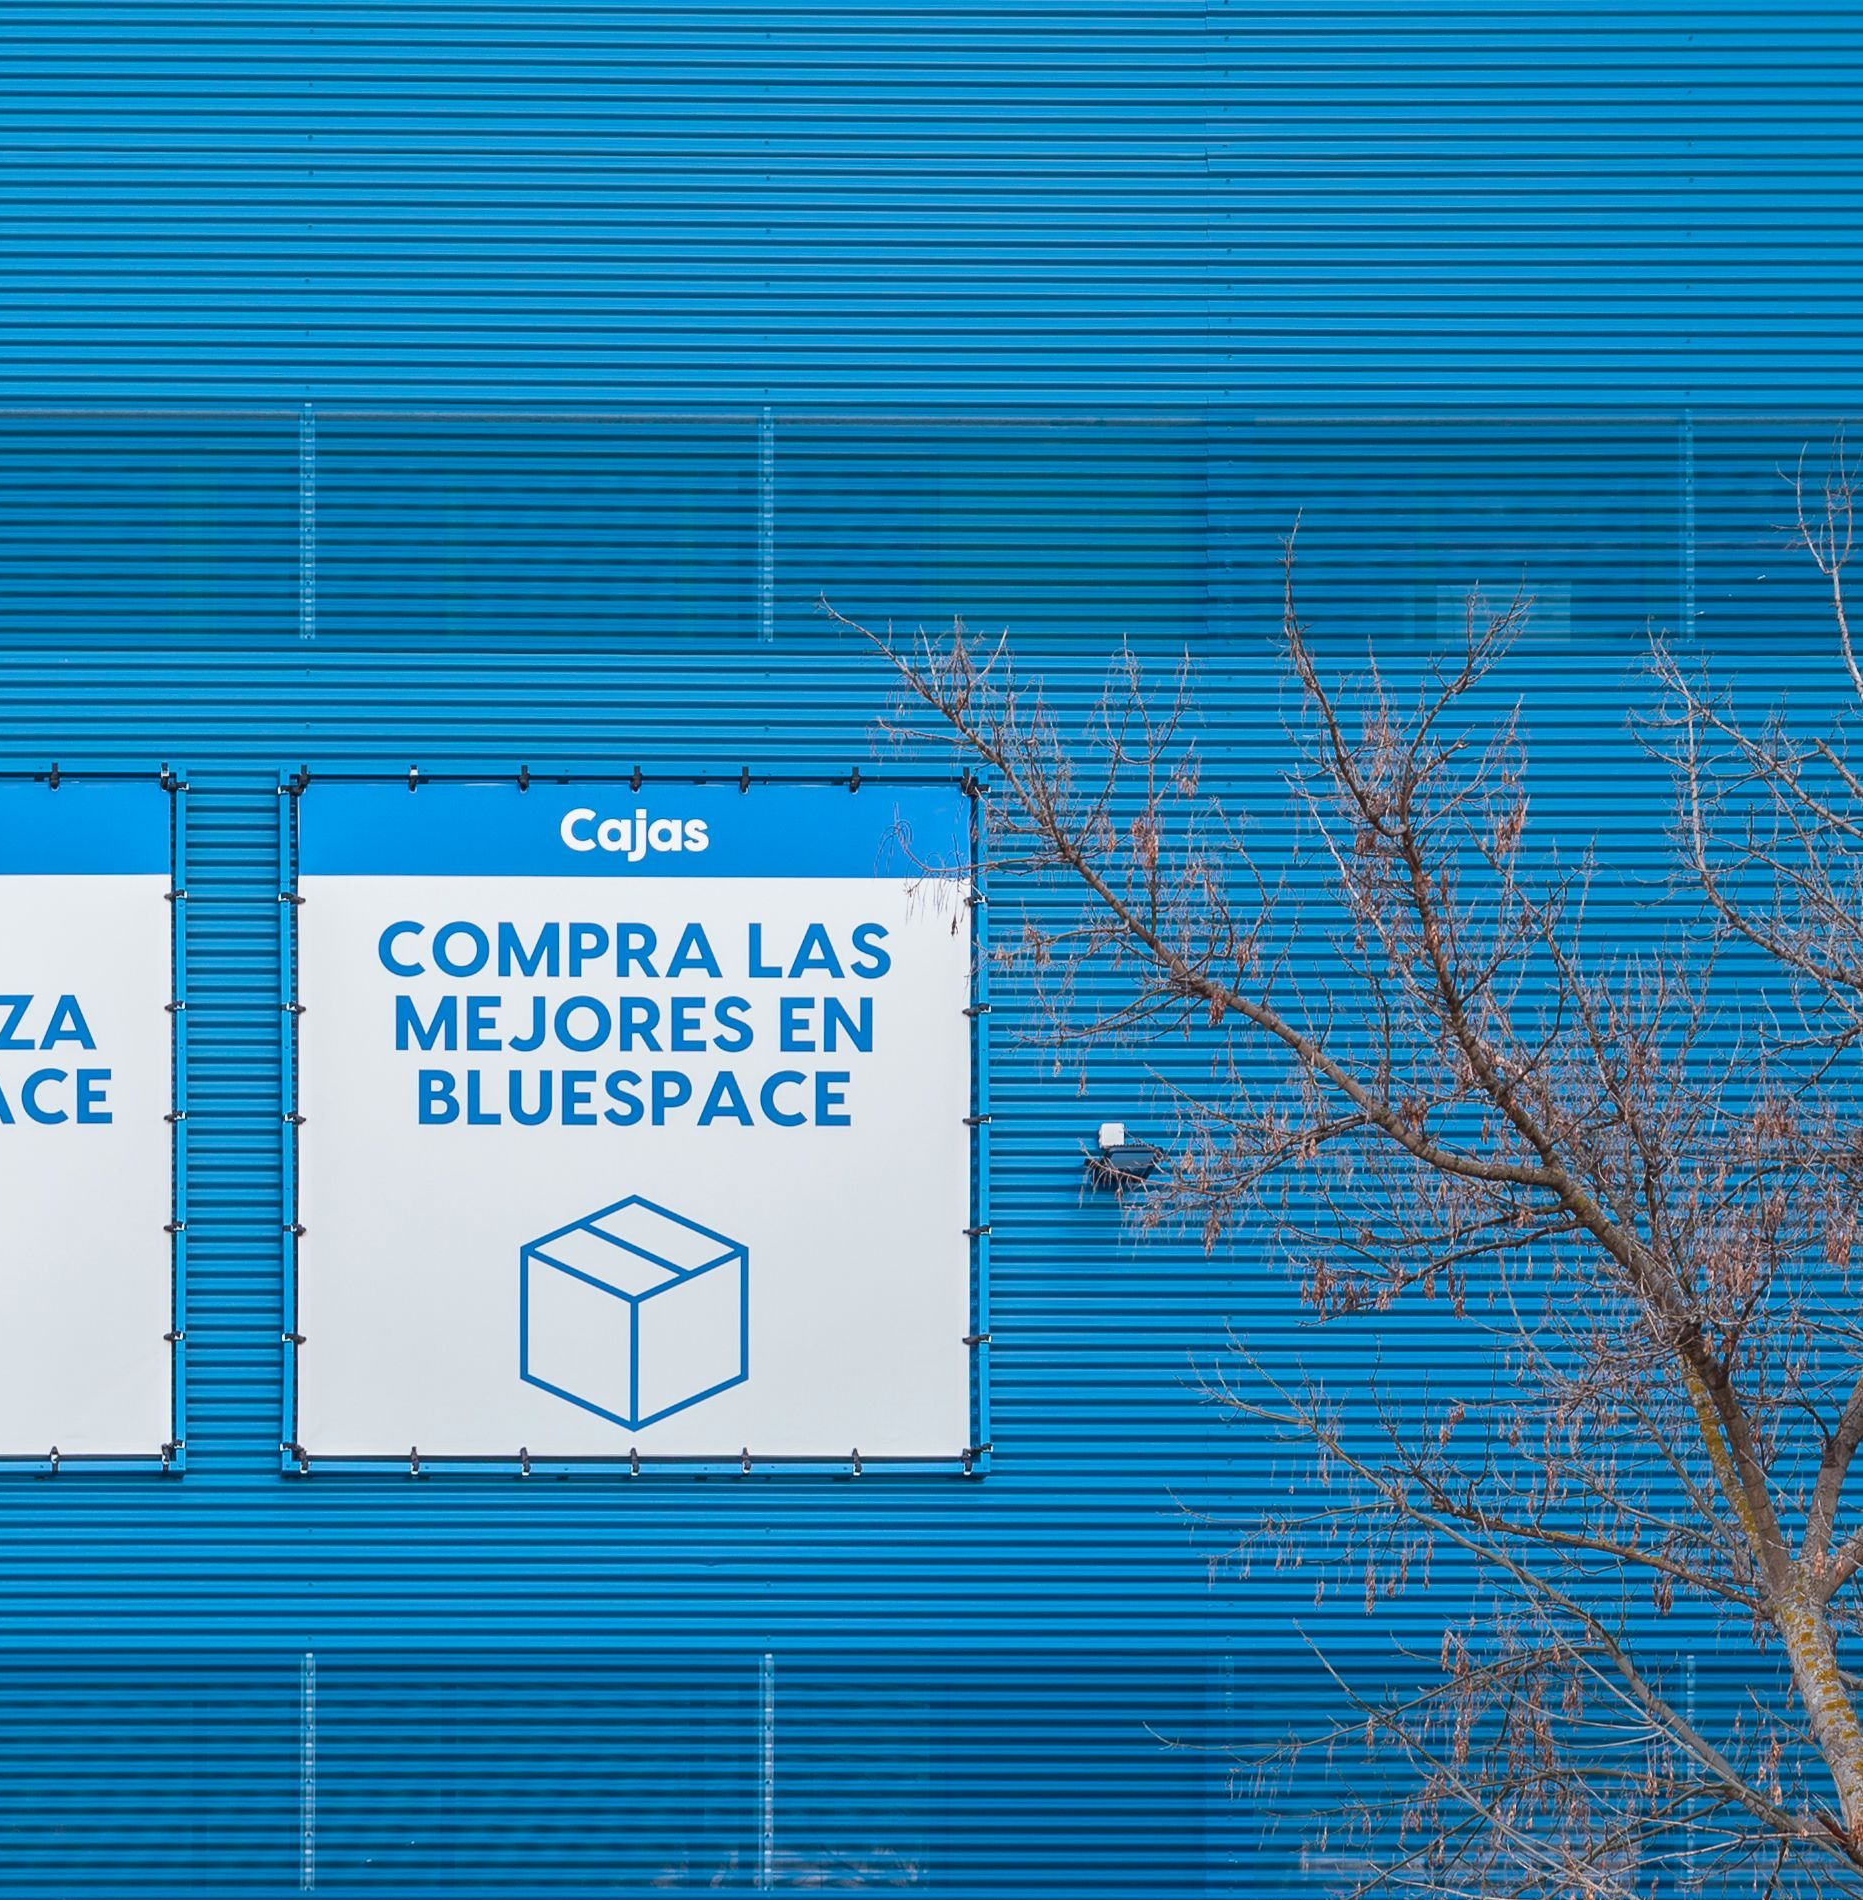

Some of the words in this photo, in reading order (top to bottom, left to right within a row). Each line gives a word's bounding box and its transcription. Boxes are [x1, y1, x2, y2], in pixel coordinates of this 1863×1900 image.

[560, 808, 709, 861] Cajas
[377, 920, 723, 978] COMPRA
[748, 922, 892, 979] LAS
[395, 994, 754, 1053] MEJORES
[779, 997, 873, 1053] EN
[418, 1069, 851, 1127] BLUESPACE
